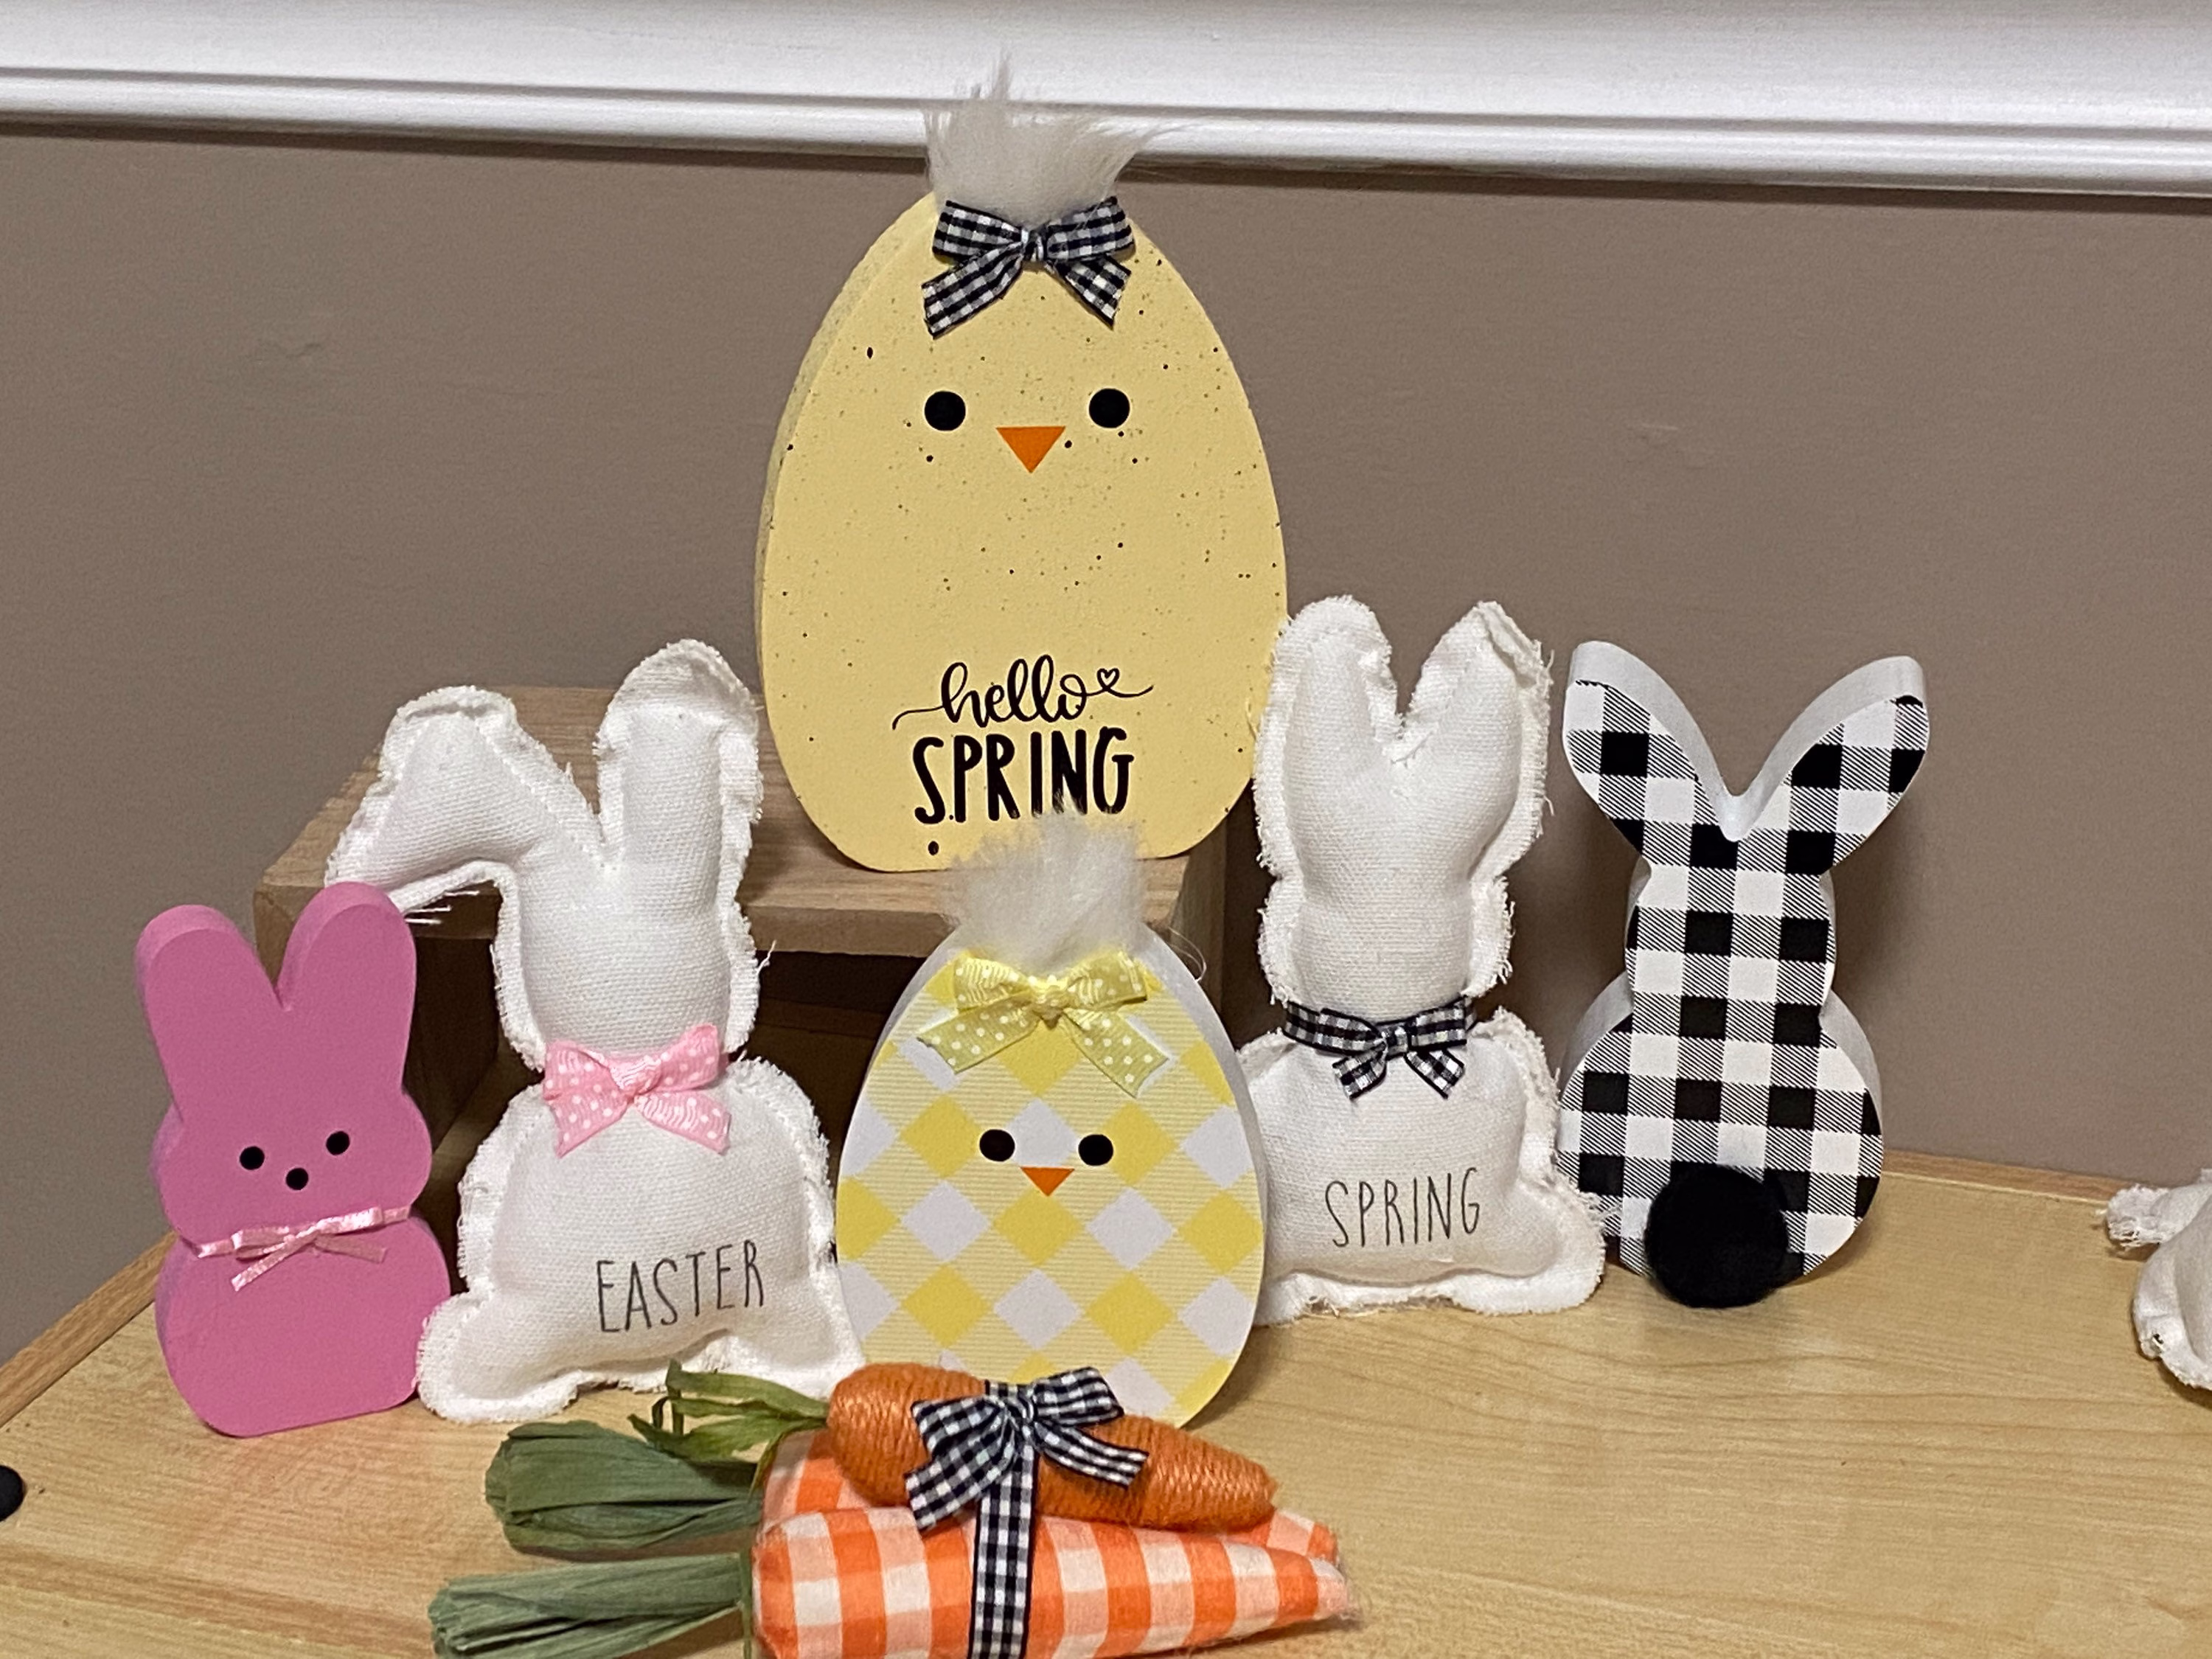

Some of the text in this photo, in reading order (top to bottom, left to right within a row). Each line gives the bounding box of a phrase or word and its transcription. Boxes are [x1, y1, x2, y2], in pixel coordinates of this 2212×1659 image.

[891, 654, 1154, 729] hello
[911, 726, 1135, 824] SPRING
[1324, 1166, 1481, 1248] SPRING
[596, 1239, 765, 1333] EASTER
